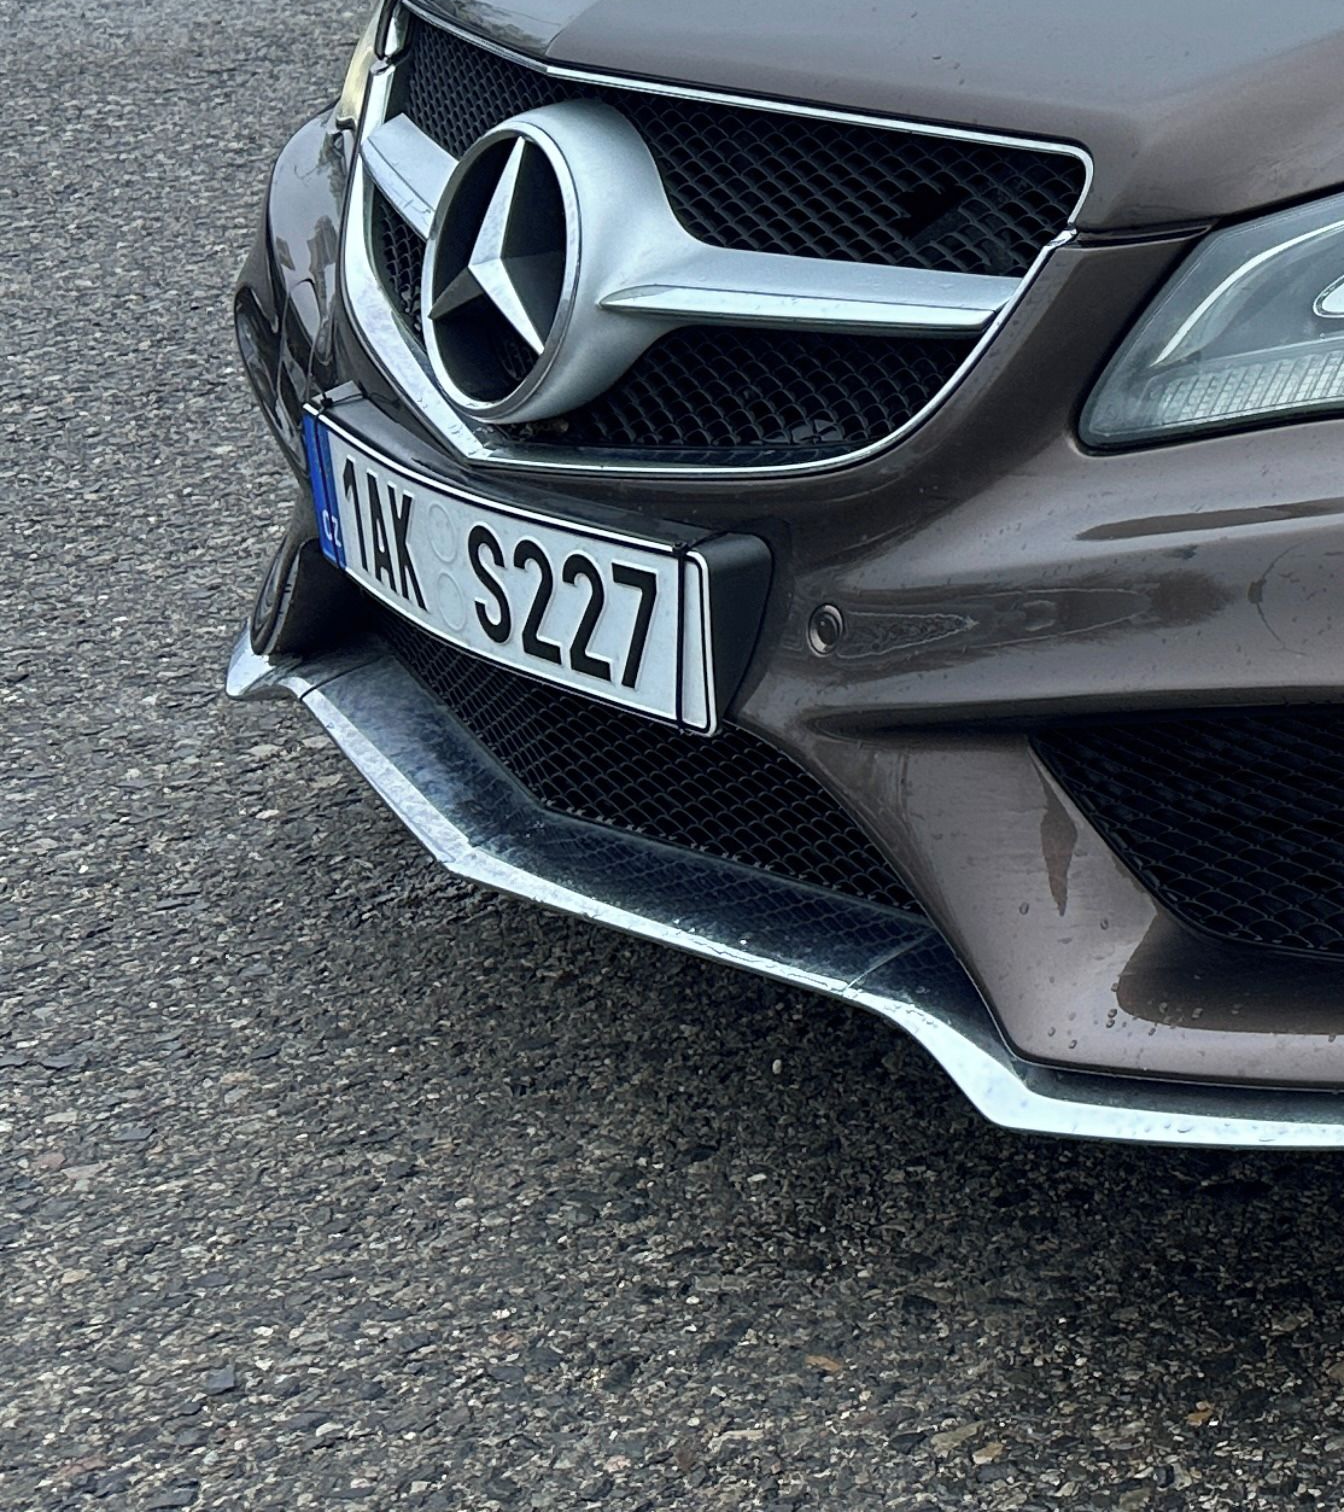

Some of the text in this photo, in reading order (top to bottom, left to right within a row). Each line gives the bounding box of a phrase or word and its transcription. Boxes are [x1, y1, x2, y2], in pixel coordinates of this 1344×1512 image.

[322, 509, 342, 548] CZ
[342, 456, 658, 690] 1AK S227
